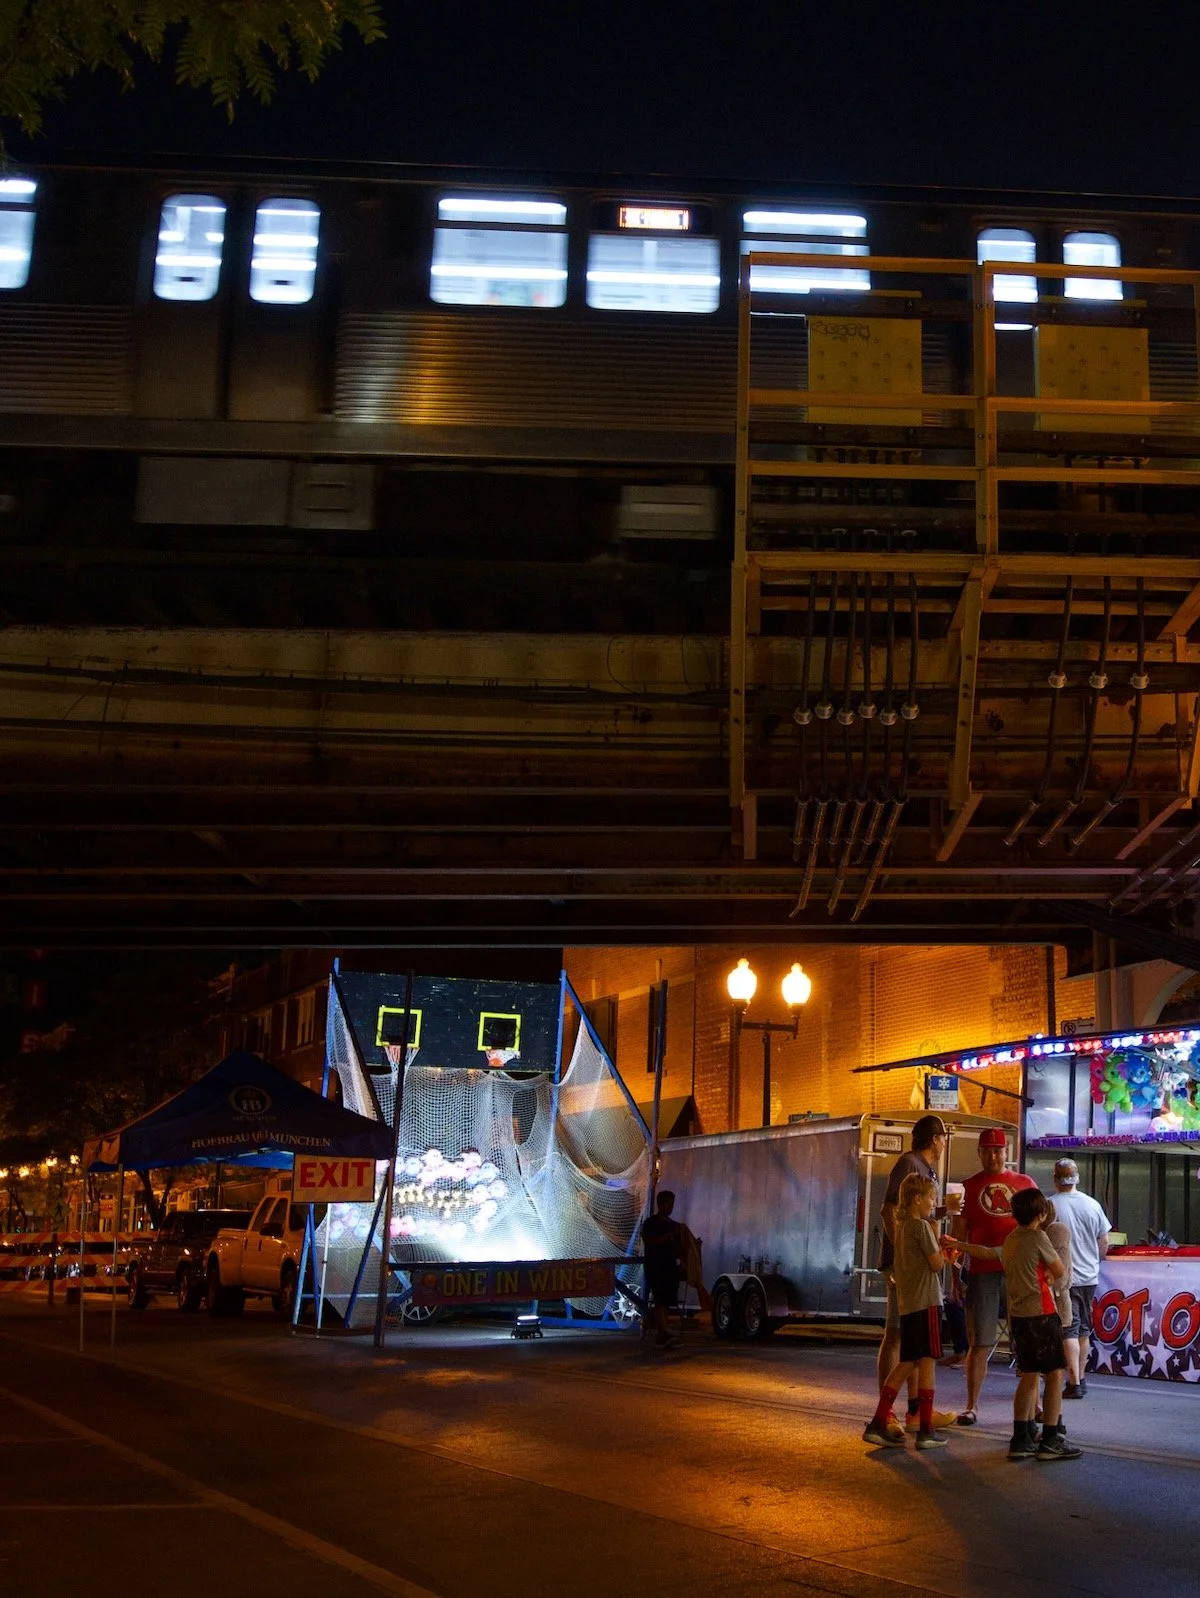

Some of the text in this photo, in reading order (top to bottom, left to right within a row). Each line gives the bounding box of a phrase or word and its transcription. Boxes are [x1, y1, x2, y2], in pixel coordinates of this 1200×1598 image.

[300, 1161, 370, 1188] EXIT
[442, 1269, 588, 1297] ONE IN WINS
[1091, 1288, 1150, 1347] OT
